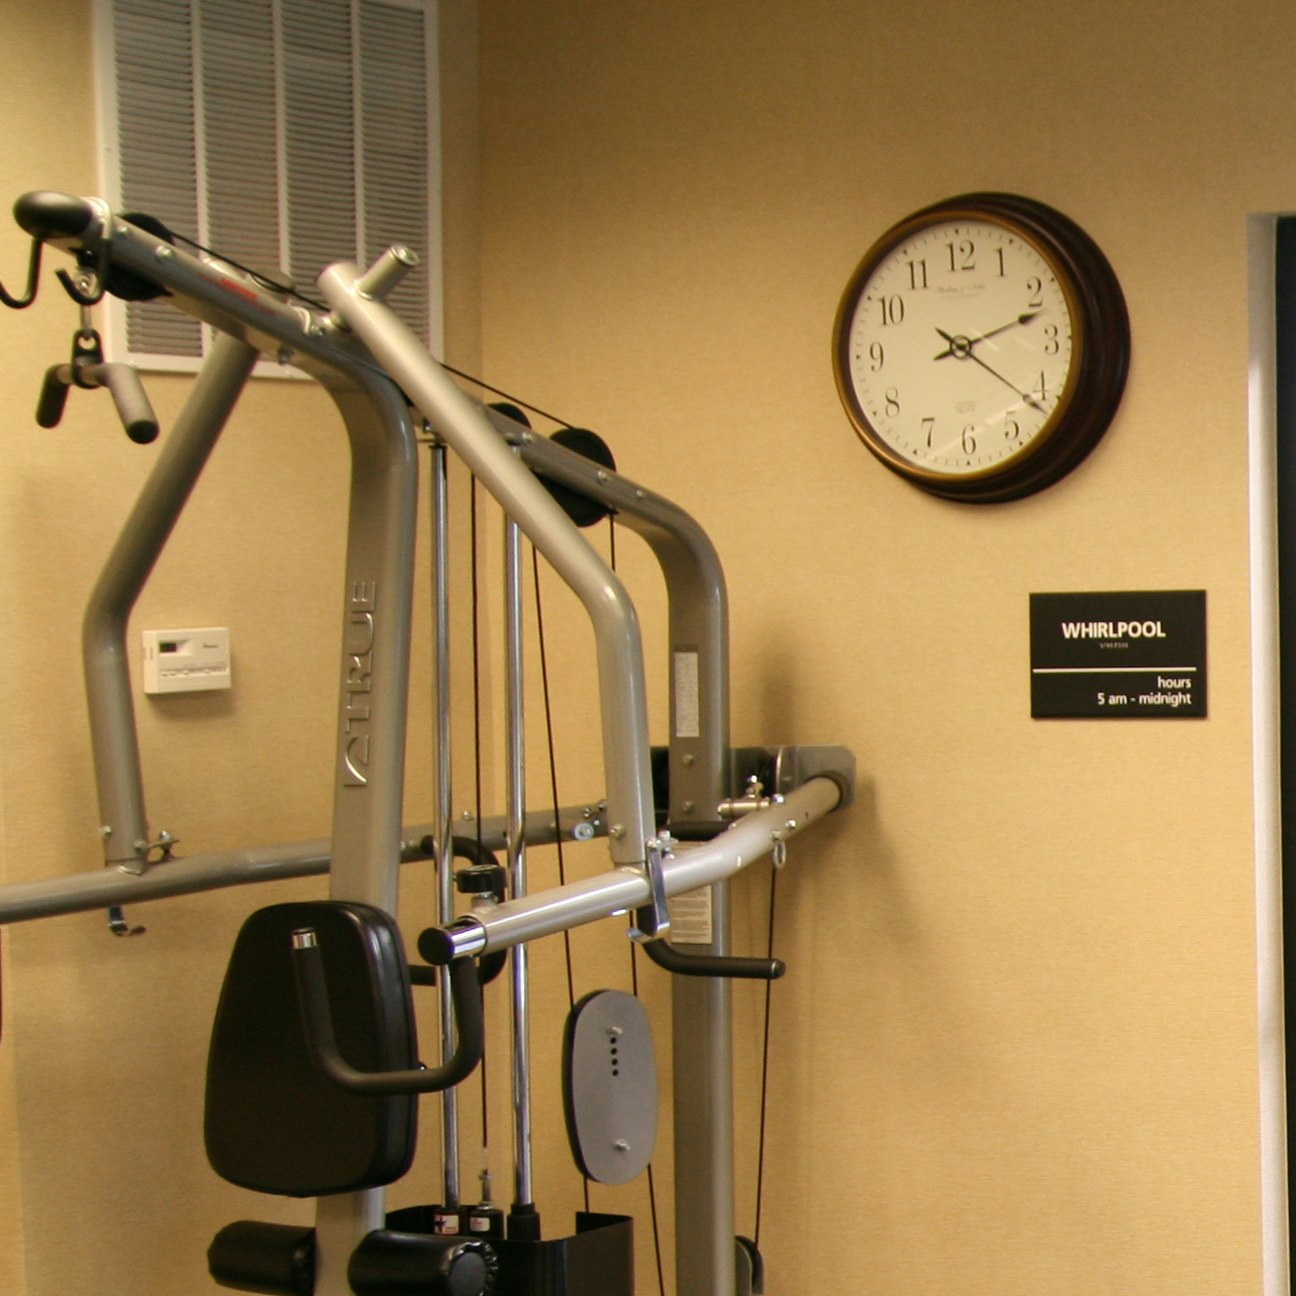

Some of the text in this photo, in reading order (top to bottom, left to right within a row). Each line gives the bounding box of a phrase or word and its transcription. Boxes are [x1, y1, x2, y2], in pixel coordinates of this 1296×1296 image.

[947, 240, 976, 272] 12
[996, 247, 1008, 278] 1
[907, 258, 929, 291] 11
[1027, 276, 1044, 307] 2
[878, 294, 905, 326] 10
[1044, 324, 1060, 355] 3
[869, 341, 885, 372] 9
[1033, 370, 1049, 401] 4
[885, 386, 900, 418] 8
[921, 417, 936, 448] 7
[961, 424, 977, 456] 6
[1004, 411, 1020, 441] 5
[1061, 620, 1167, 639] WHIRLPOOL
[1157, 676, 1192, 689] hours
[1097, 692, 1106, 705] 5
[1108, 694, 1128, 705] am
[1139, 692, 1192, 707] midnight
